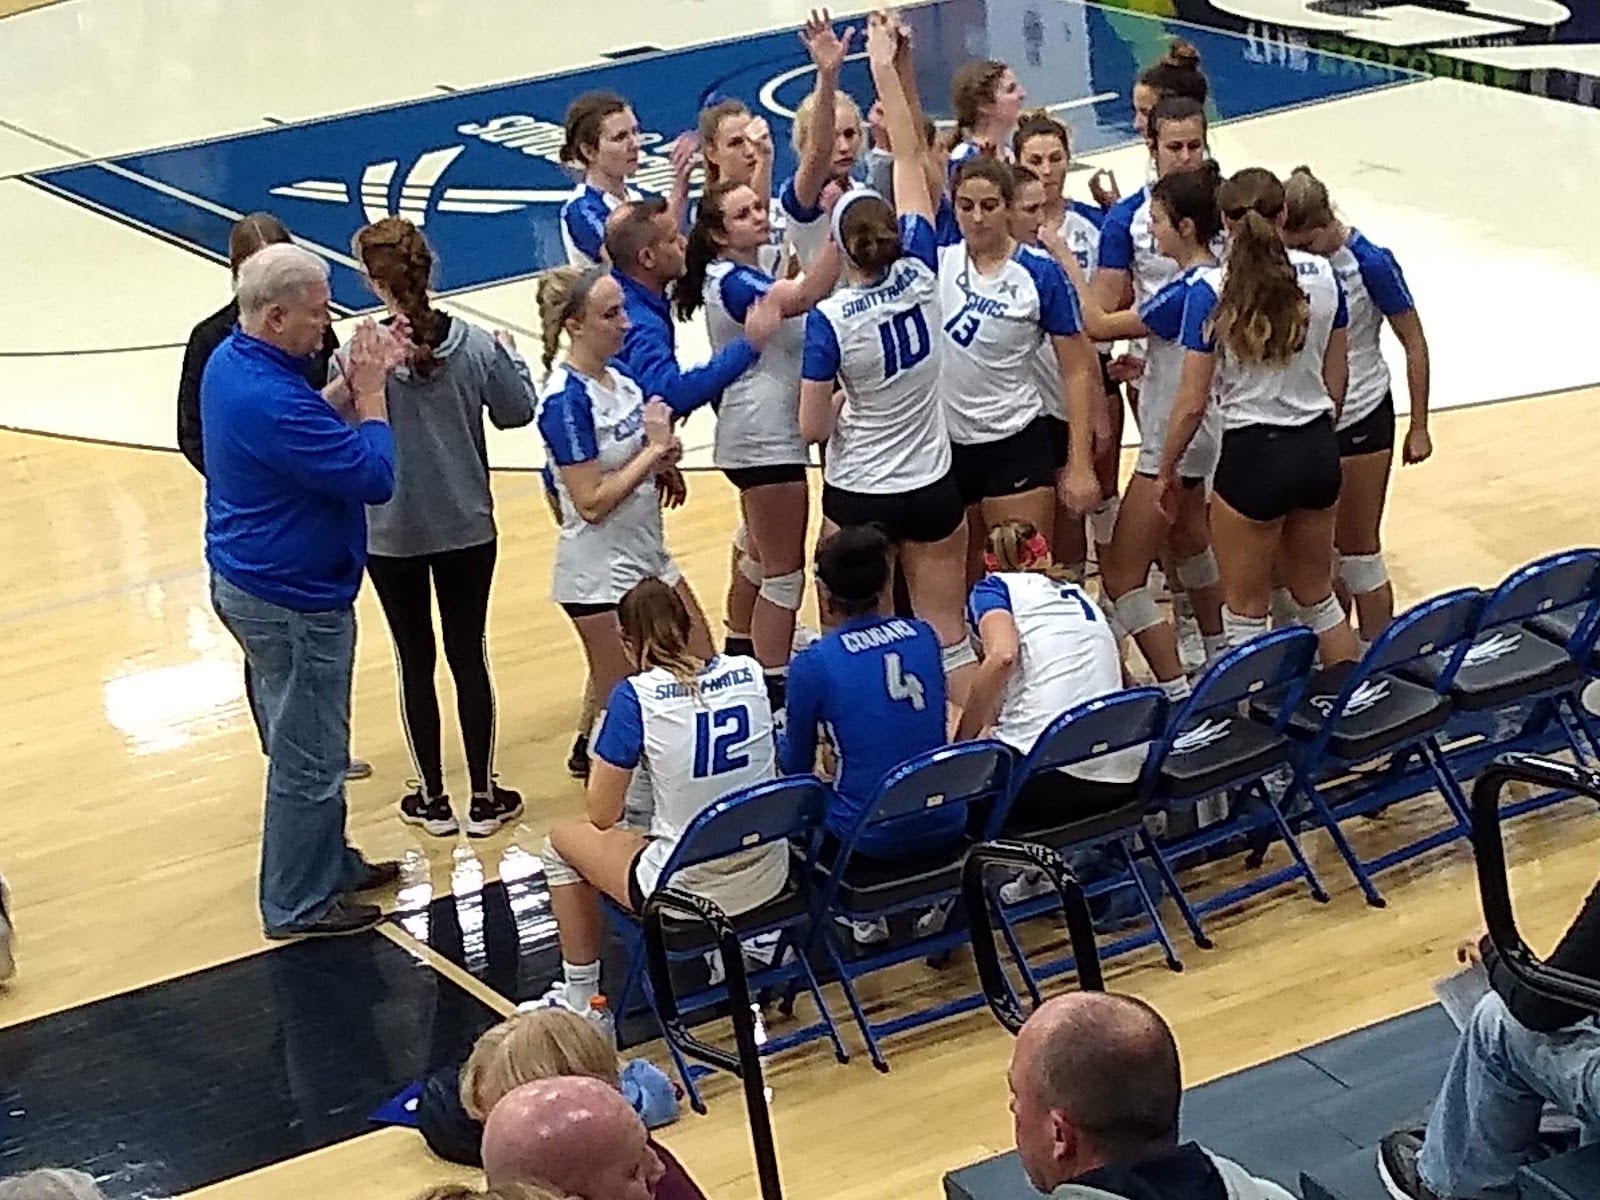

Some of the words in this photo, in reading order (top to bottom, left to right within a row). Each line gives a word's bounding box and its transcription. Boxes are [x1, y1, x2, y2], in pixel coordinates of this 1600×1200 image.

[878, 302, 931, 380] 10
[944, 301, 981, 348] 13
[1060, 588, 1097, 622] 7
[883, 652, 927, 712] 4
[693, 704, 751, 778] 12
